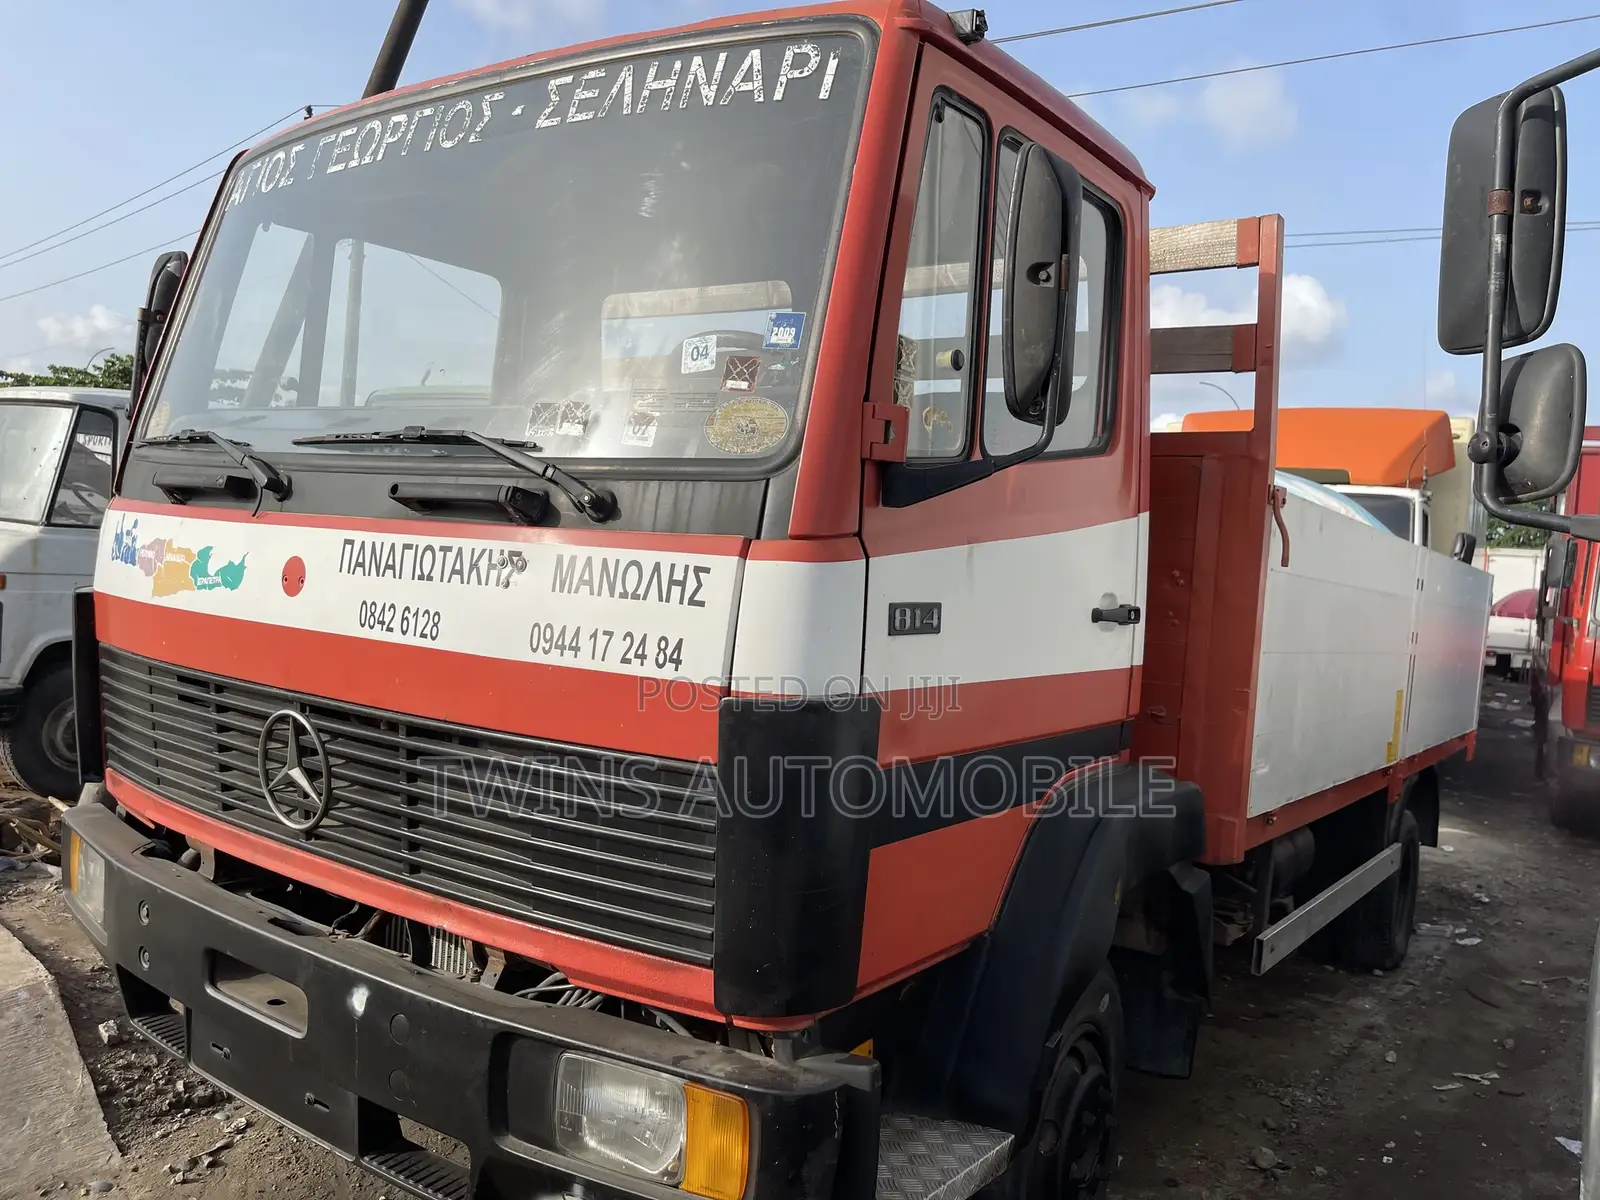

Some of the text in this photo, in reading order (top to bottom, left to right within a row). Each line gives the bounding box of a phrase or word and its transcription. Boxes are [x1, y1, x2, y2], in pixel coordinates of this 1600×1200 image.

[534, 40, 842, 129] ΣΕΛΗΝΑΡΙ
[690, 344, 709, 361] 04
[338, 538, 712, 608] ΠΑΝΑΓΙΩΤΑΚΗΣ ΜΑΝΩΛΗΣ
[358, 600, 442, 641] 0842 6128
[892, 606, 940, 632] 814
[529, 622, 684, 672] 0944 17 24 84
